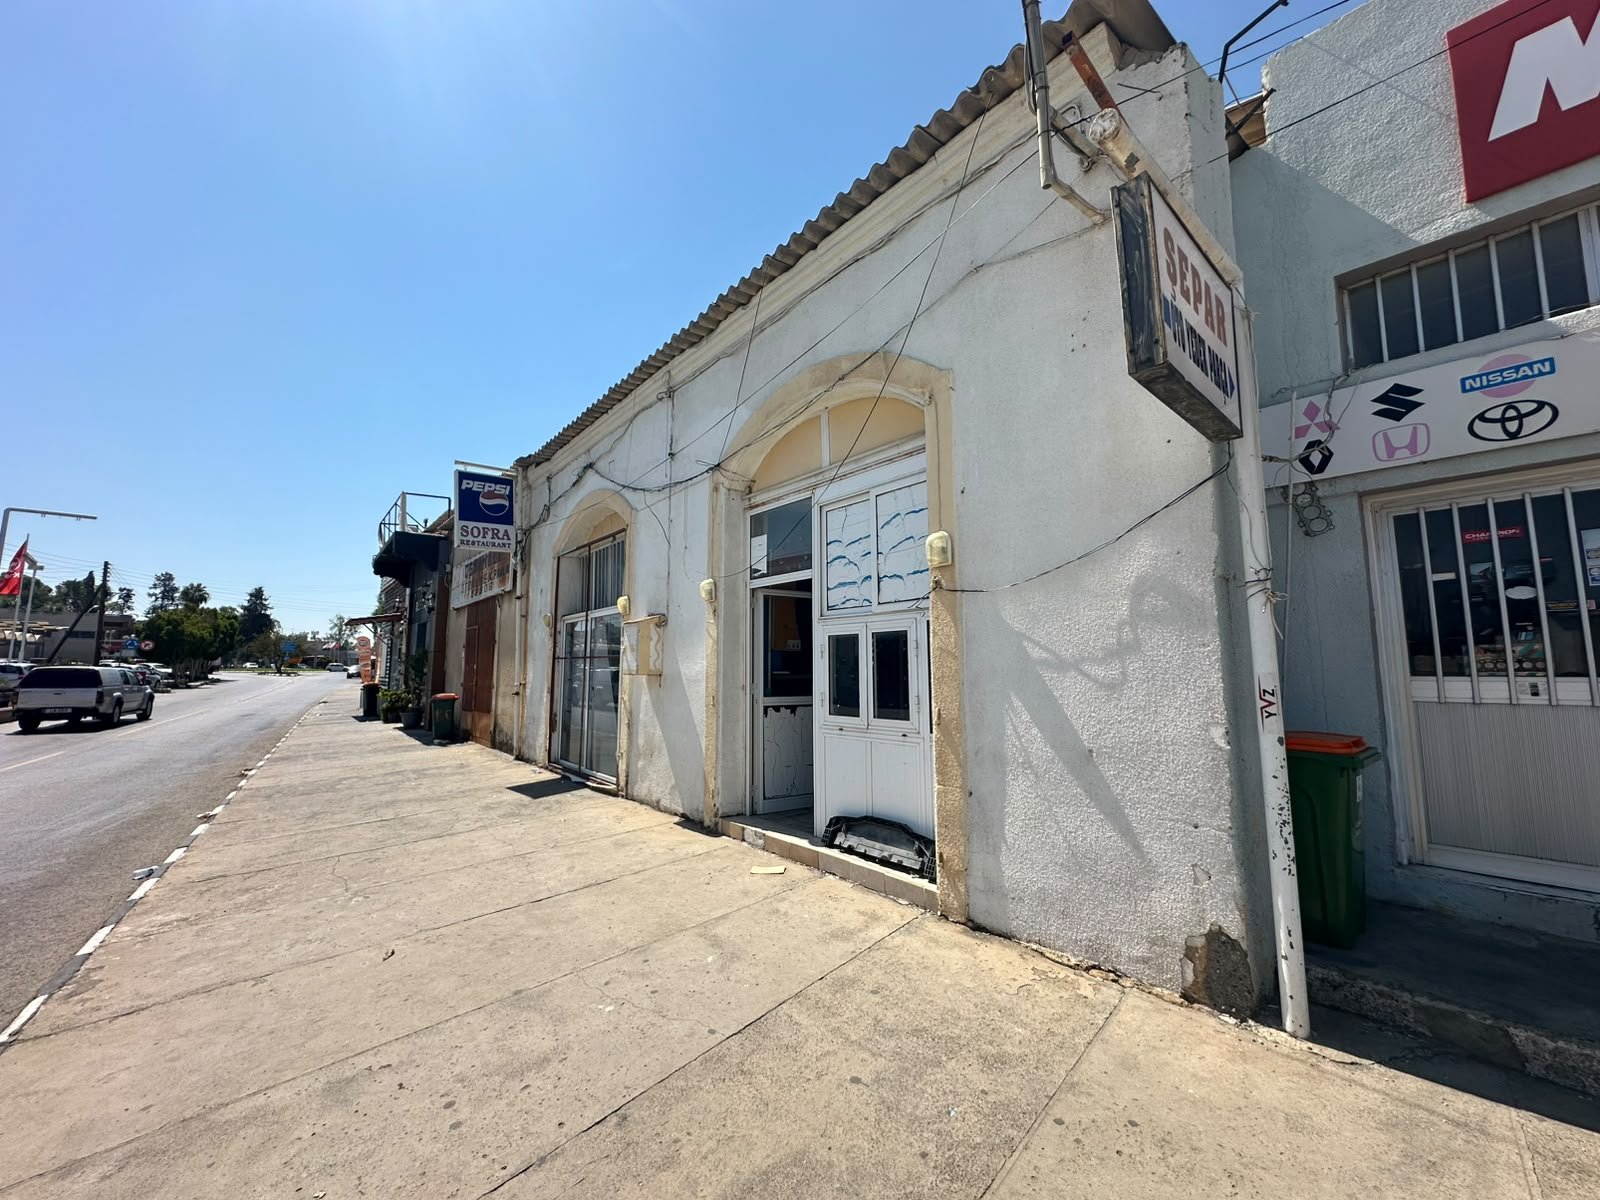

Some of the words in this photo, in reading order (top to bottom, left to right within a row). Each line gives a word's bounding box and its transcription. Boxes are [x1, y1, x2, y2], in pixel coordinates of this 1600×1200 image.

[1464, 361, 1551, 391] NISSAN
[461, 479, 510, 495] PEPSI
[460, 525, 511, 540] SOFRA
[460, 539, 512, 549] RESTAURANT
